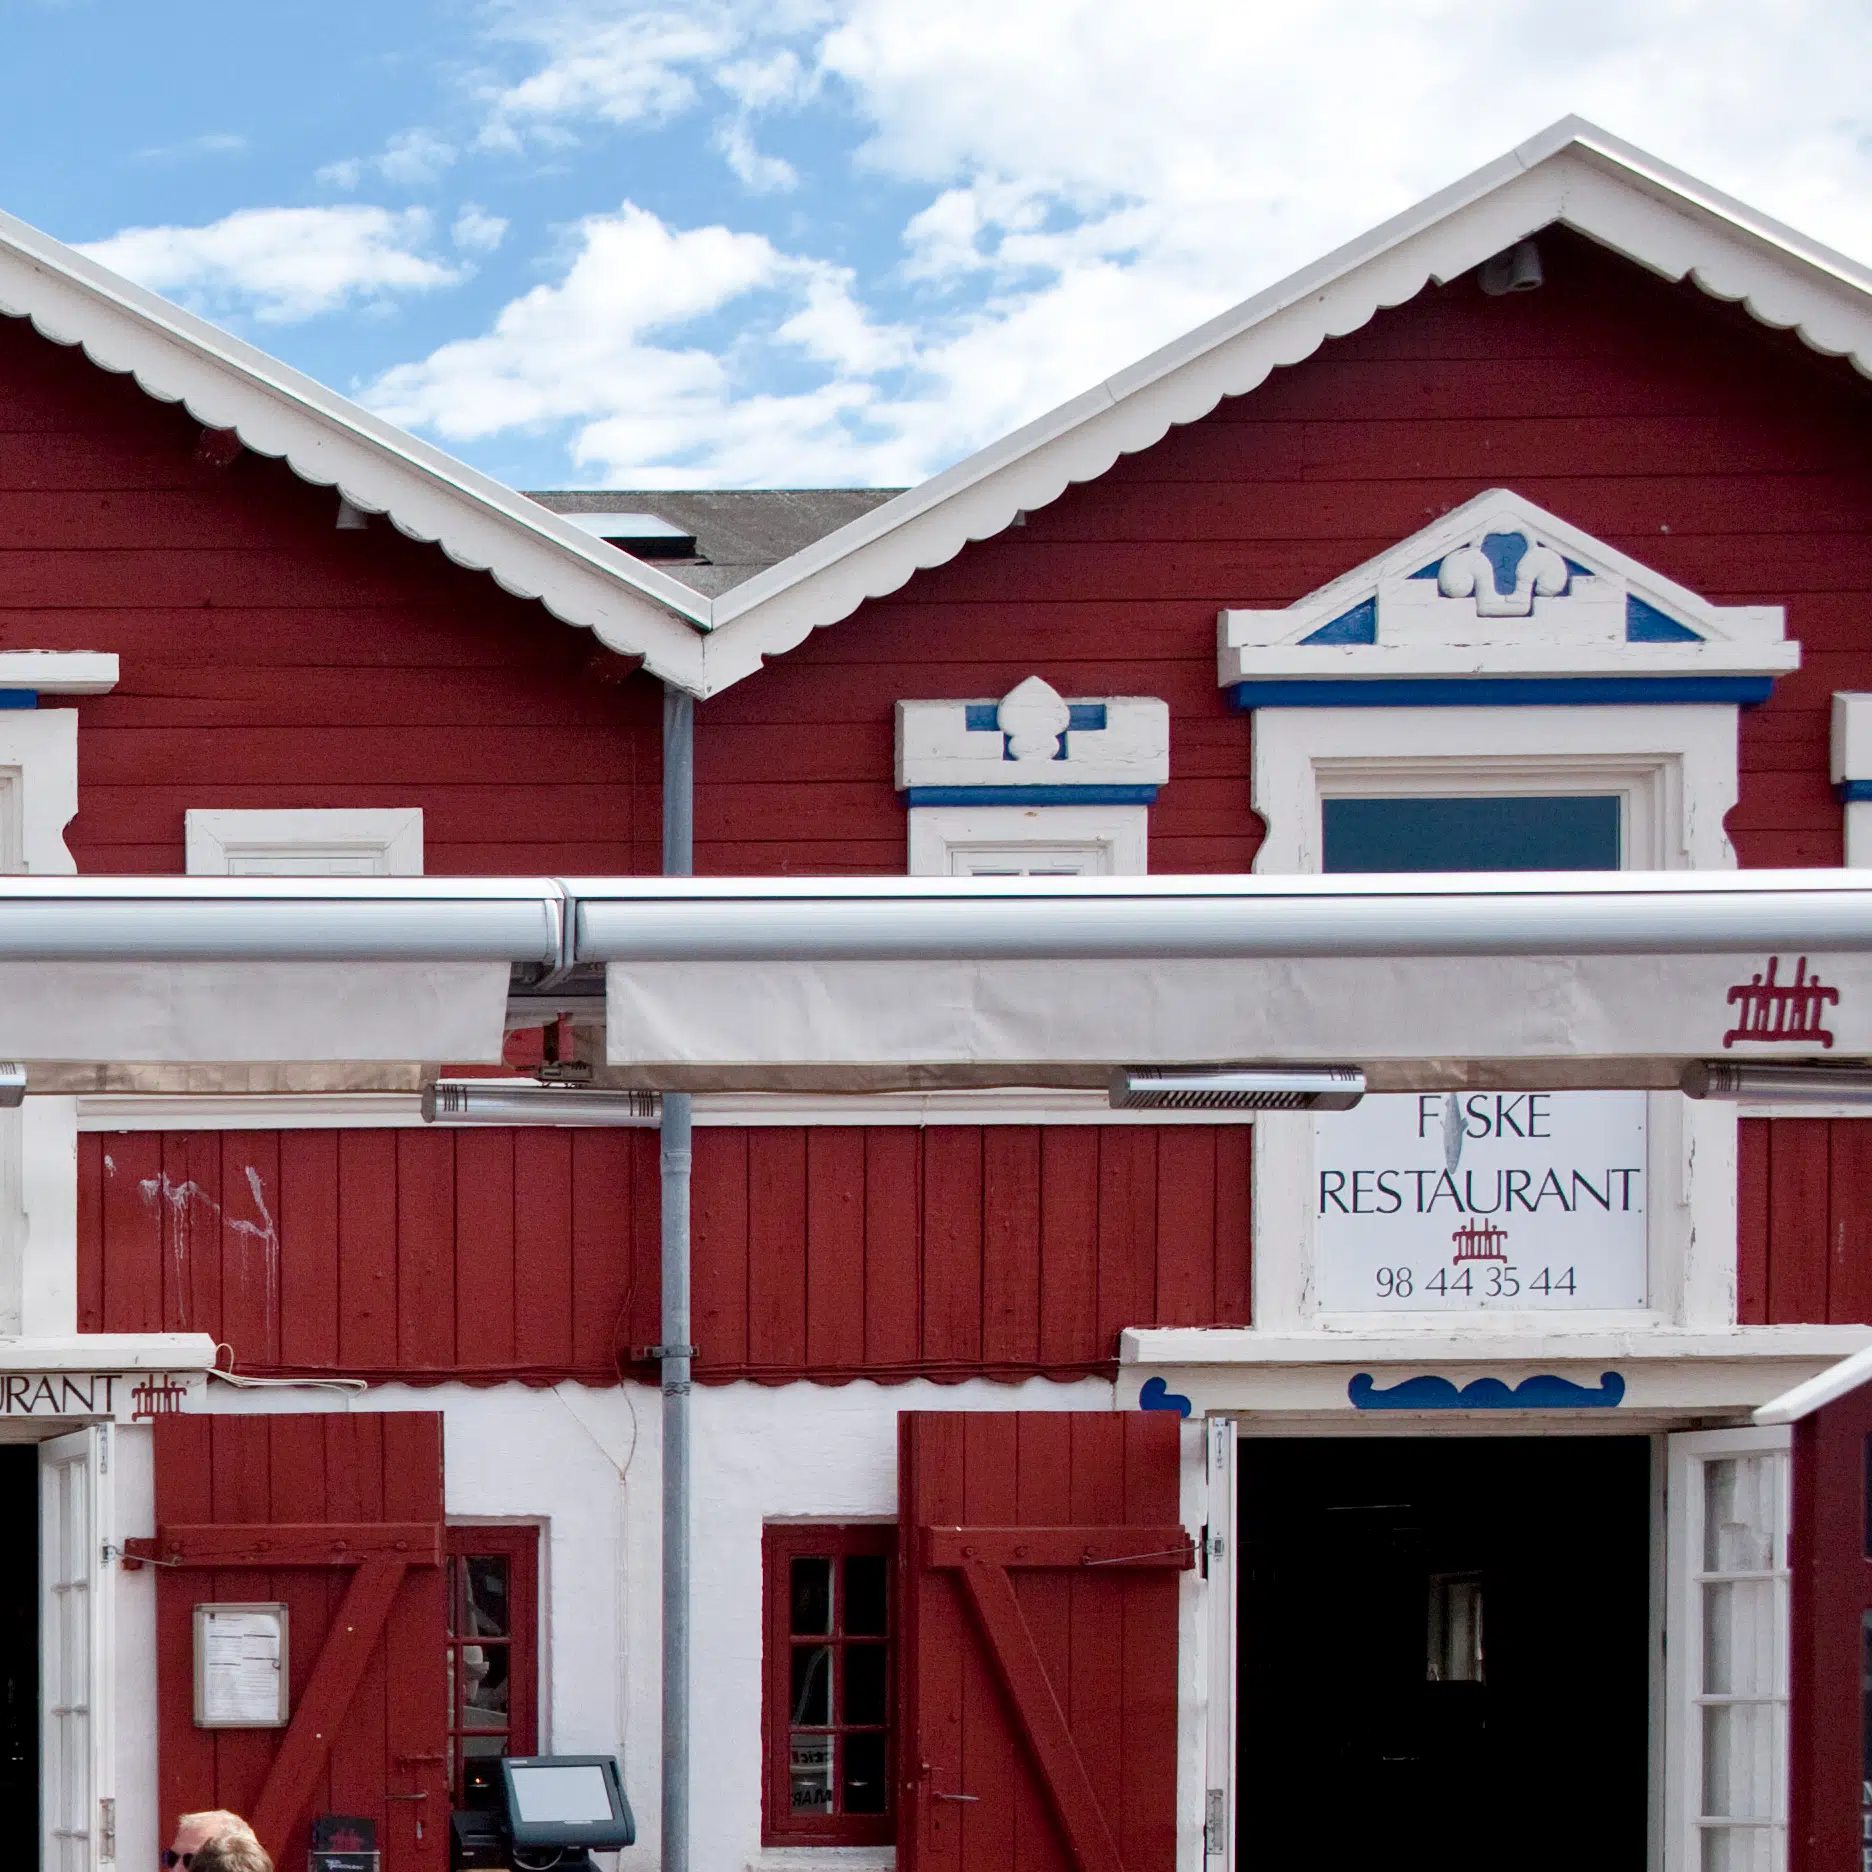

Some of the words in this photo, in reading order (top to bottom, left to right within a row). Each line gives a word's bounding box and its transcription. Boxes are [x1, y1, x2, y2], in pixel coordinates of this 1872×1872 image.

[1319, 1167, 1641, 1214] RESTAURANT
[1375, 1266, 1414, 1299] 98
[1425, 1266, 1474, 1298] 44
[1485, 1266, 1521, 1298] 35
[1529, 1266, 1577, 1297] 44
